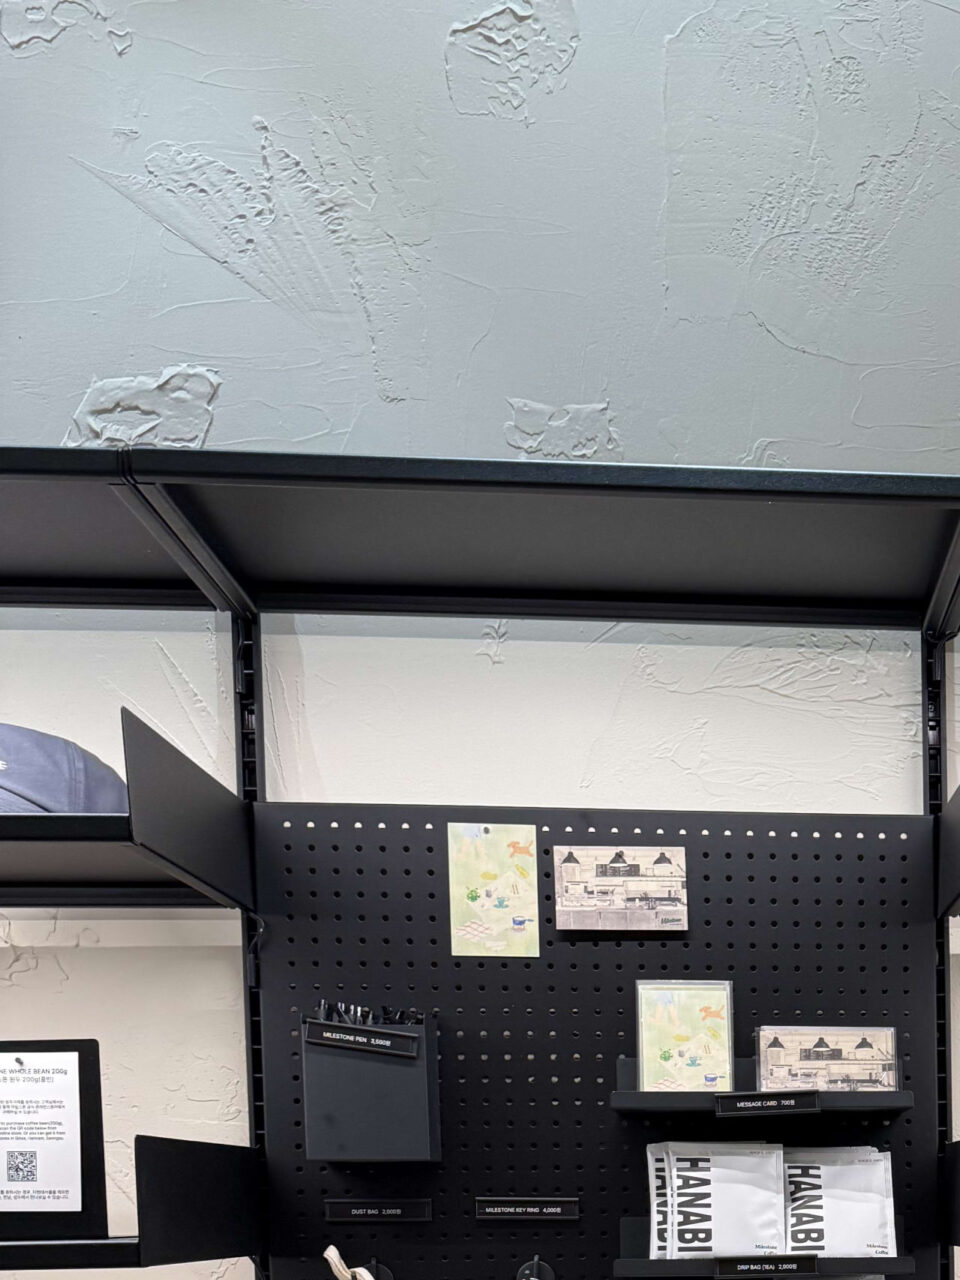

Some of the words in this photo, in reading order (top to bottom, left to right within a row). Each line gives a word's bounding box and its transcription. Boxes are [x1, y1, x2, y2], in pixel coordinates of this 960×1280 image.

[323, 1032, 354, 1041] MILESTONE
[675, 1158, 712, 1252] HANABI
[787, 1165, 825, 1251] HANABI
